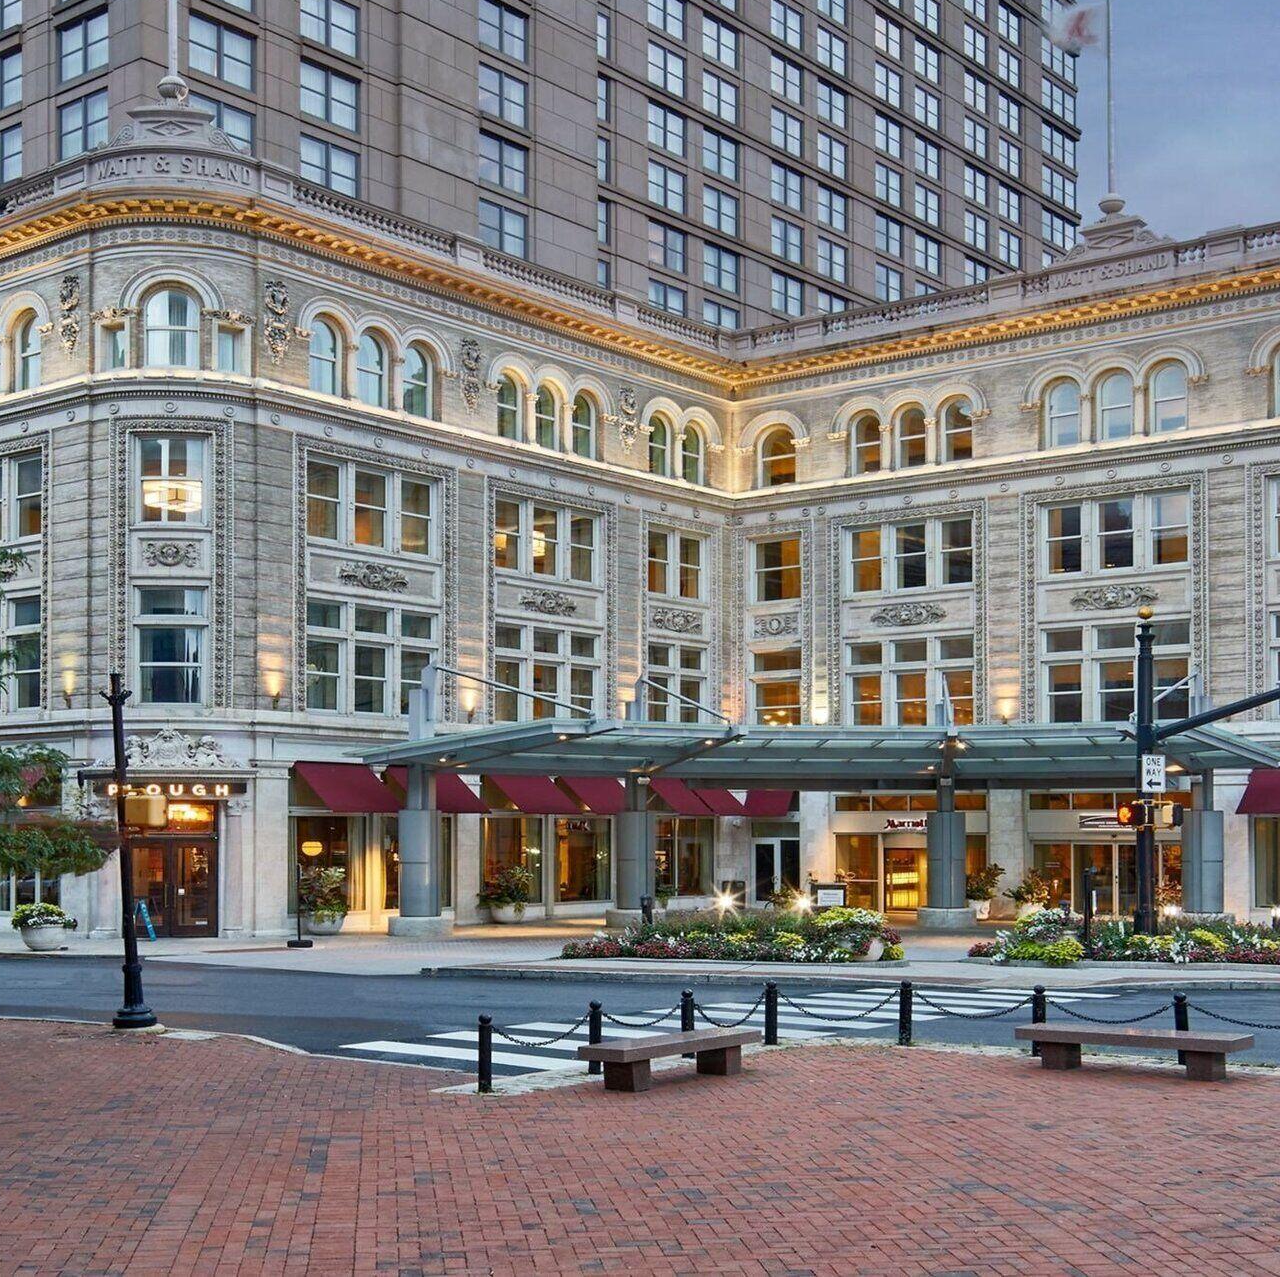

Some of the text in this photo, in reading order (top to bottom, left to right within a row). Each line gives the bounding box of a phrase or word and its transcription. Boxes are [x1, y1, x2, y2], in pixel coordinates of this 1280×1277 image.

[95, 155, 252, 186] WATT & SHAND
[1053, 254, 1169, 290] WATT & SHAND
[1145, 757, 1161, 766] ONE
[1145, 768, 1162, 777] WAY
